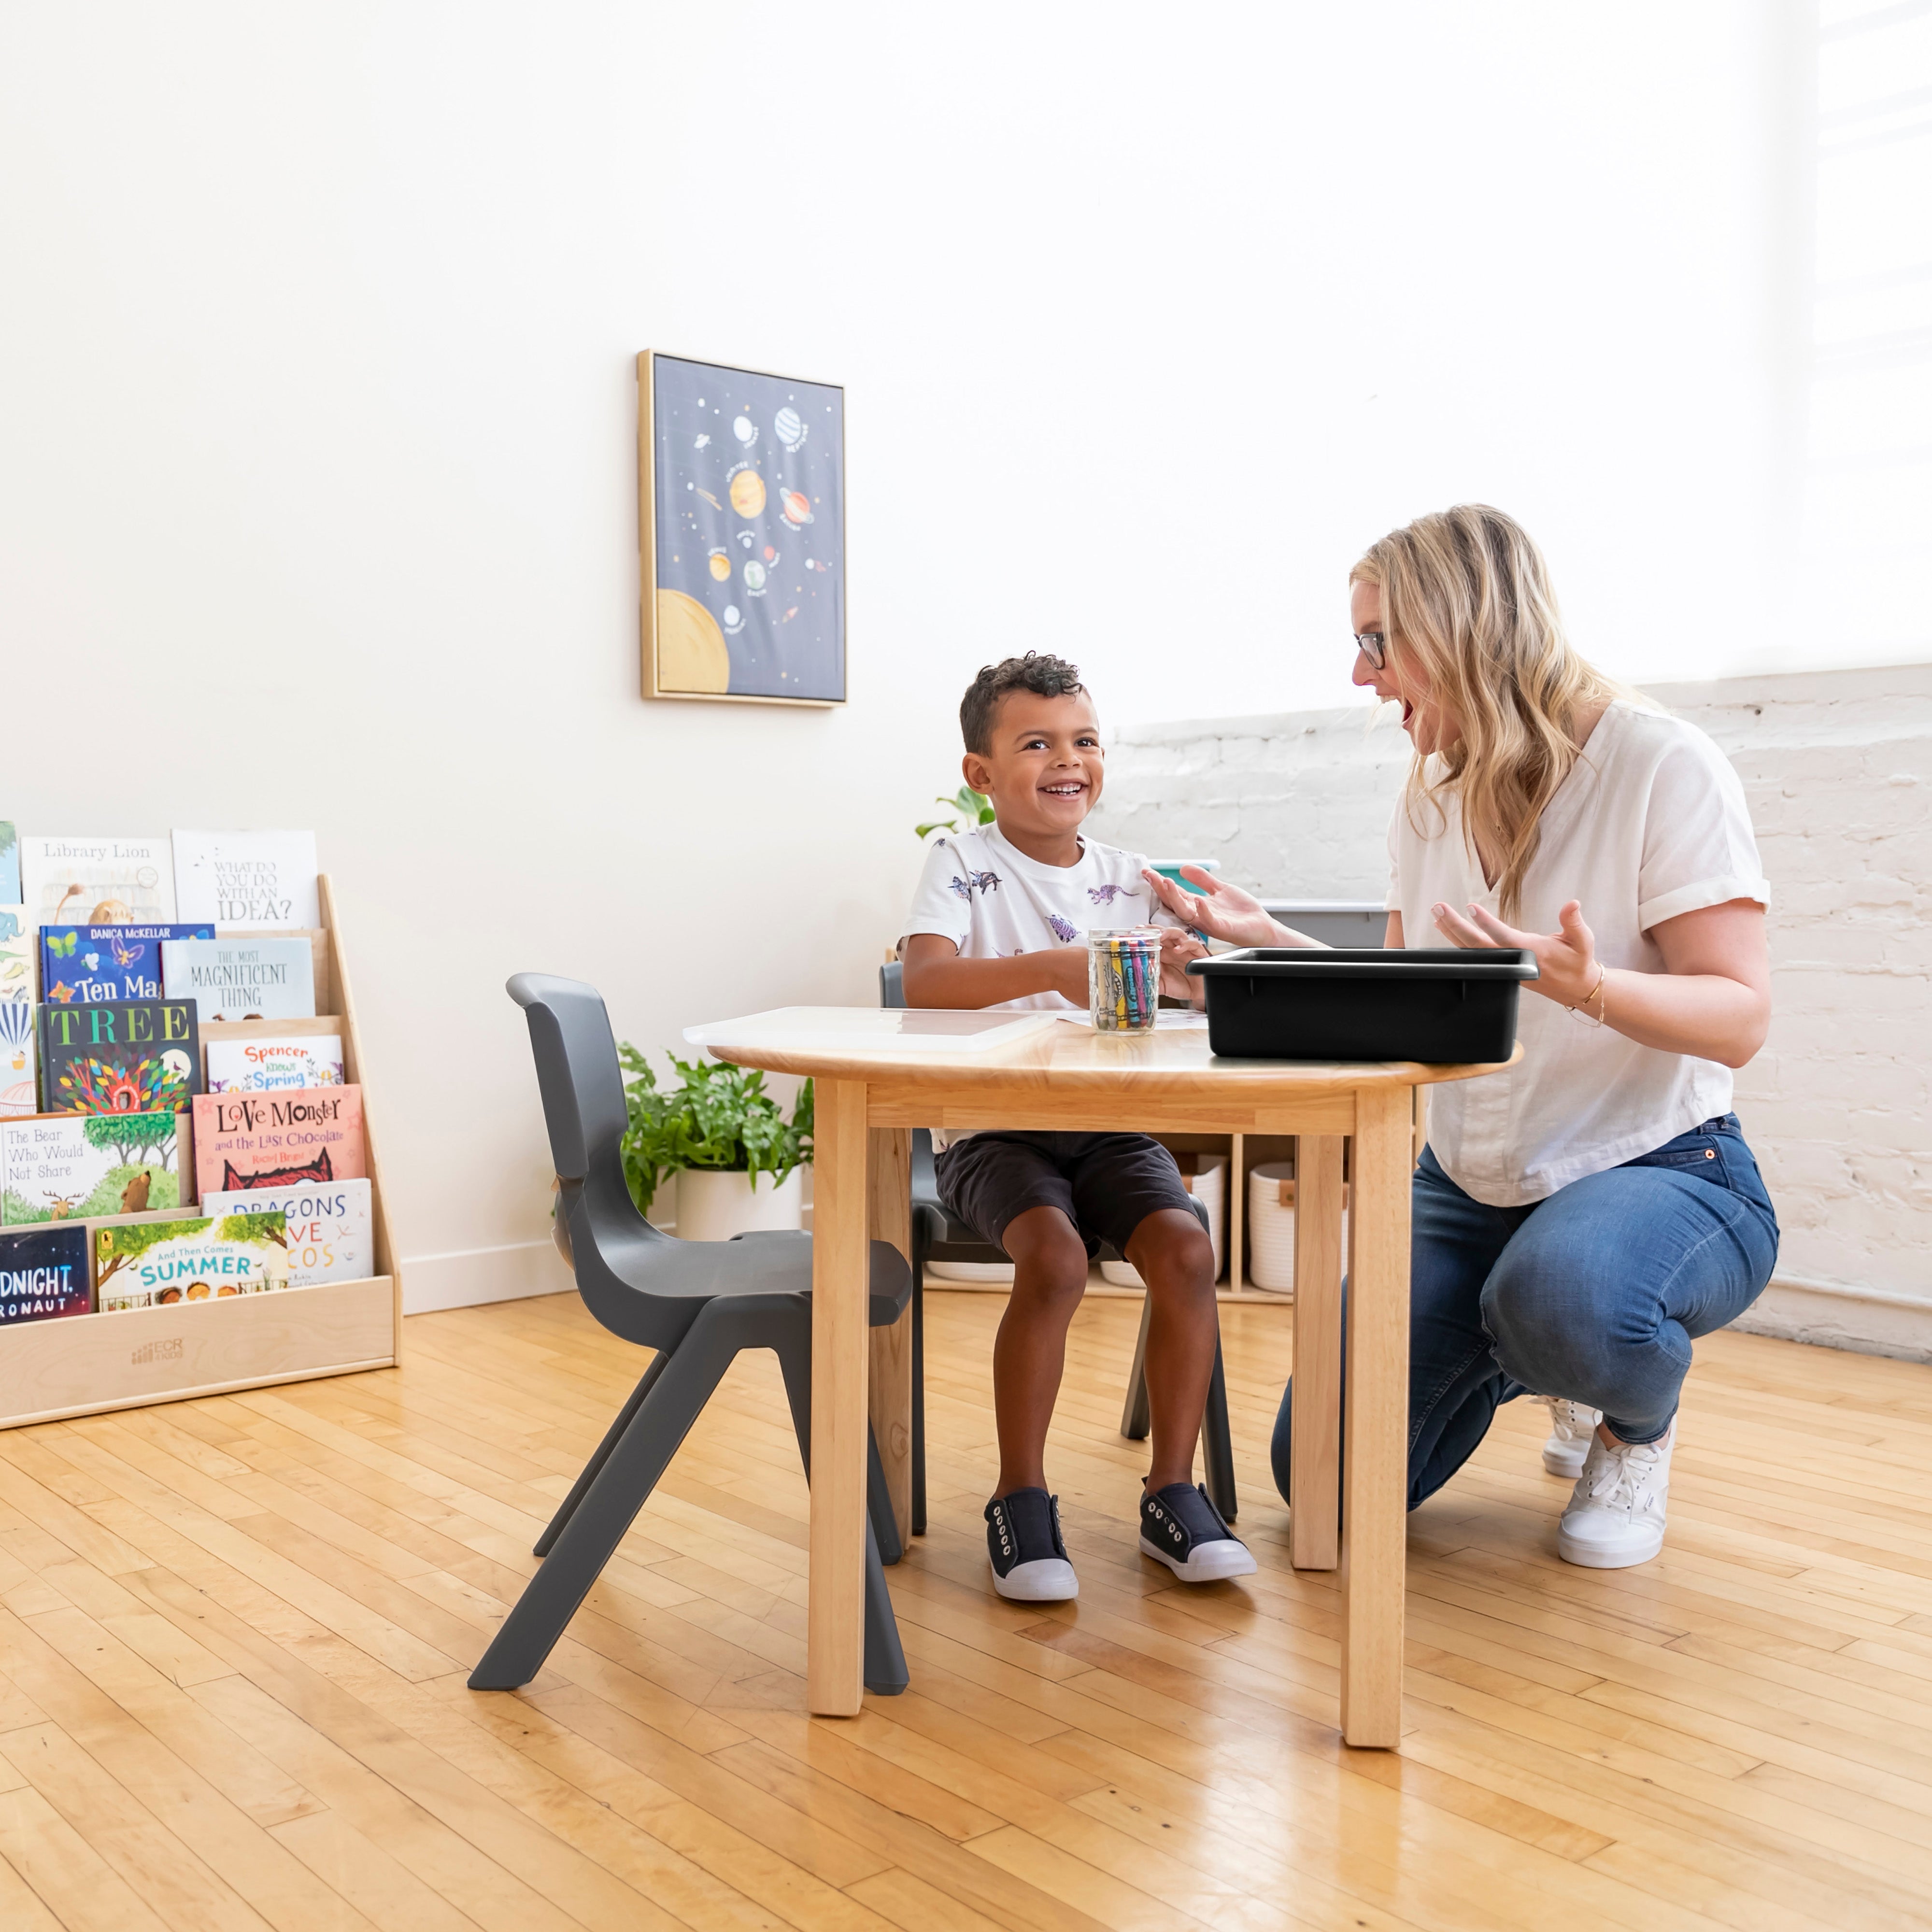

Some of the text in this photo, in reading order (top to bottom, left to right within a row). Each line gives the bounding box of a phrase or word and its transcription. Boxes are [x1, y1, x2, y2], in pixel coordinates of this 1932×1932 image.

[43, 843, 151, 861] Library Lion
[214, 862, 276, 872] WHAT DO
[216, 874, 277, 886] YOU DO
[217, 887, 277, 899] WITH AN
[217, 899, 292, 920] IDEA?
[90, 928, 170, 939] DANICA McKELLAR
[217, 950, 259, 963] THE MOST
[191, 964, 287, 986] MAGNIFICENT
[74, 977, 118, 1003] Ten
[51, 1006, 190, 1045] TREE
[244, 1046, 308, 1063] Spencer
[253, 1071, 305, 1090] Spring
[270, 1099, 341, 1127] Monster
[7, 1129, 63, 1144] The Bear
[215, 1140, 232, 1151] and
[236, 1137, 254, 1150] the
[8, 1144, 83, 1162] Who Would
[10, 1165, 71, 1180] Not Share
[289, 1222, 322, 1243] VE
[158, 1245, 233, 1261] And Then Comes
[287, 1244, 334, 1269] COS
[140, 1256, 250, 1286] SUMMER
[0, 1298, 66, 1318] RONAUT
[155, 1338, 182, 1352] ECR
